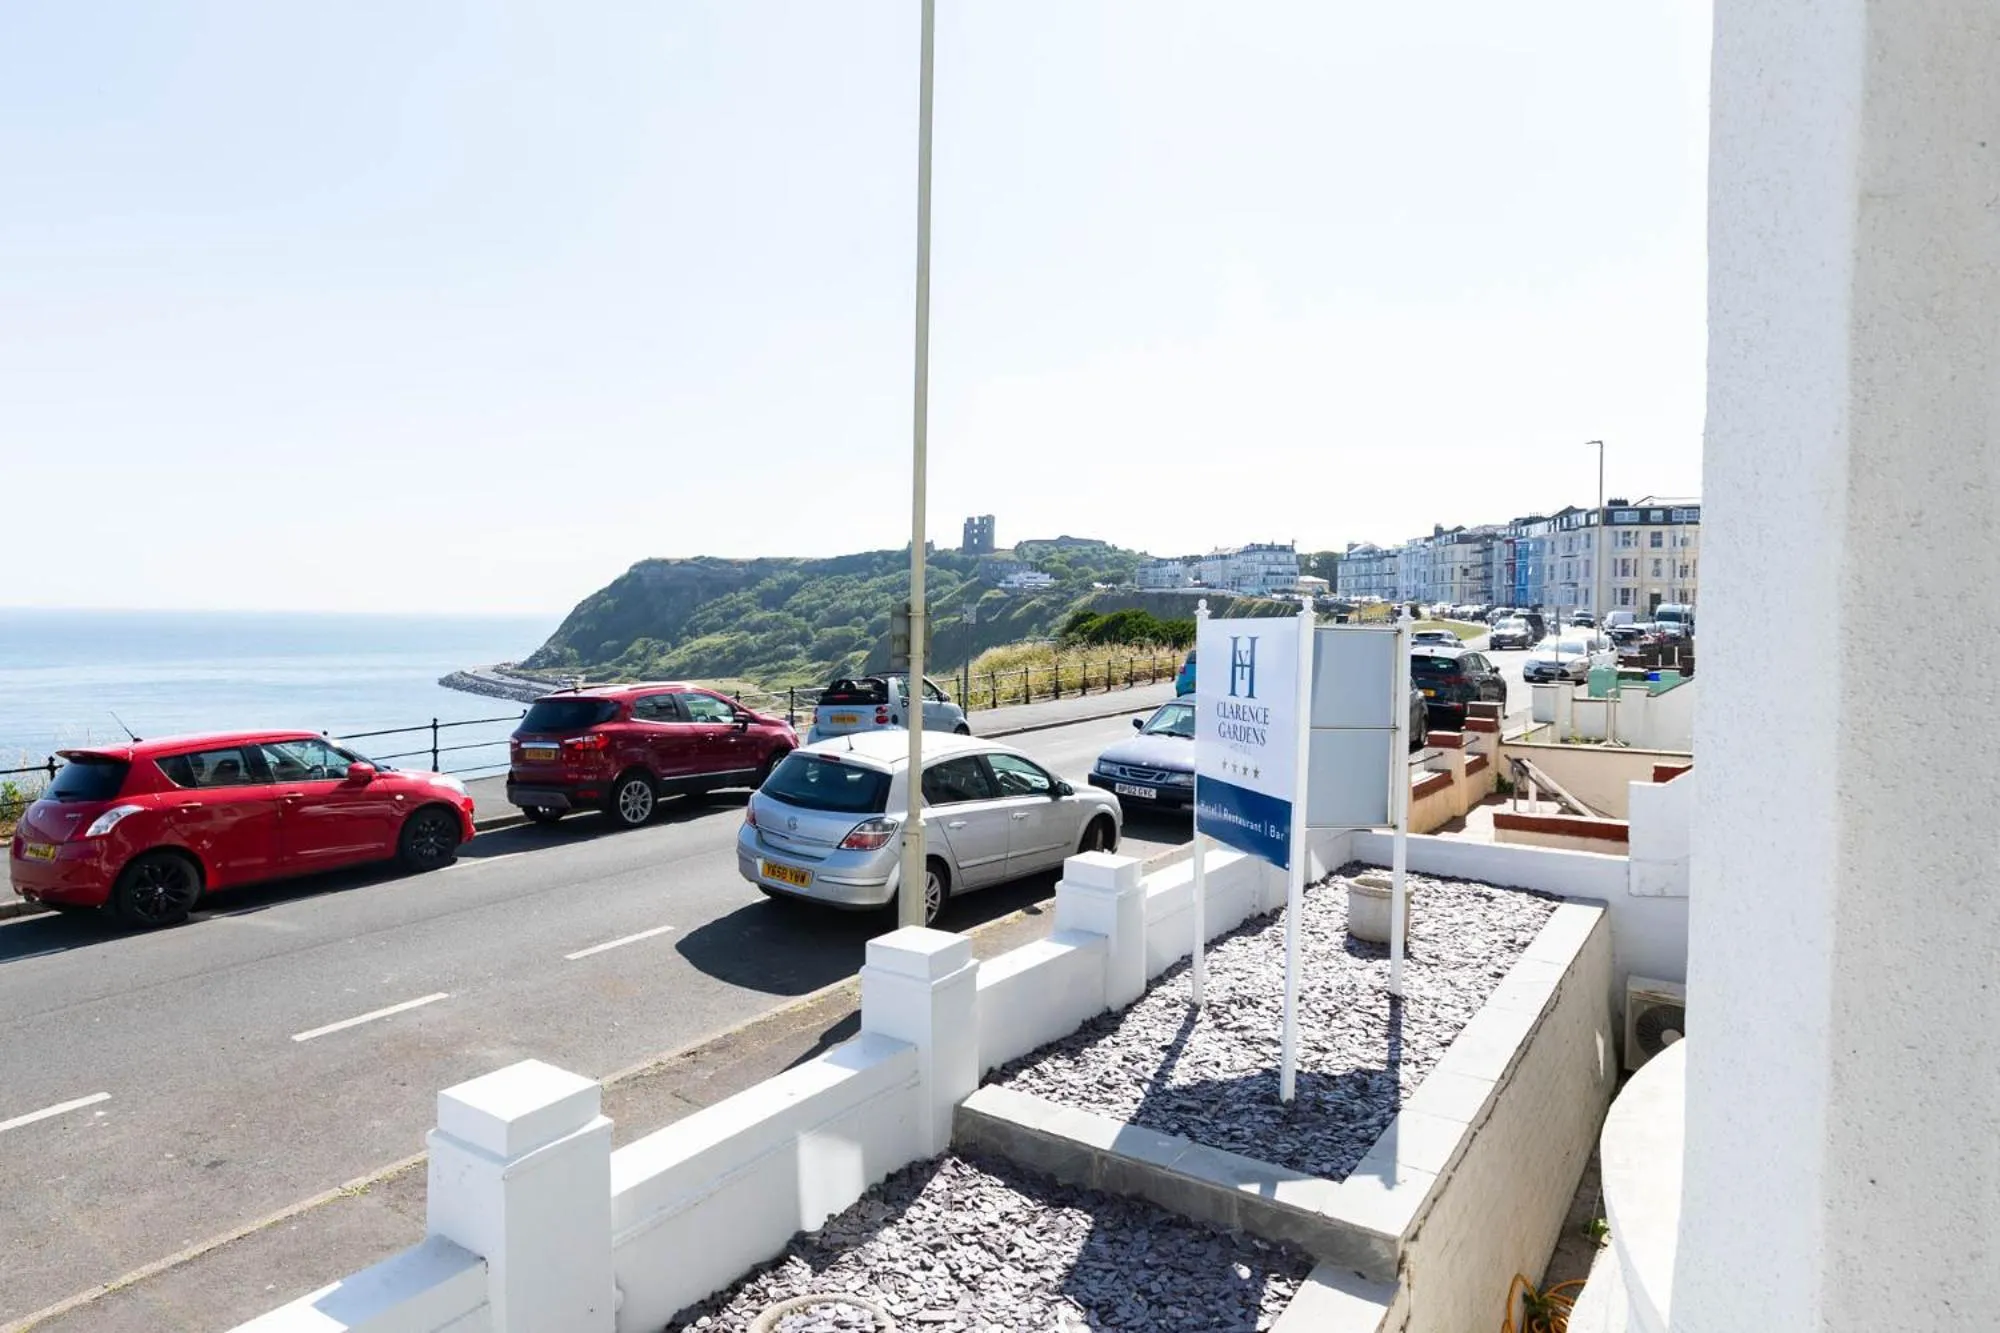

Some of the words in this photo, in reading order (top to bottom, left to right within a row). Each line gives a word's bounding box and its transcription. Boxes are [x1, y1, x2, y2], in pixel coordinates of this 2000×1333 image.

[1216, 701, 1270, 725] CLARENCE
[1218, 721, 1267, 747] GARDENS
[1223, 807, 1262, 833] Restaurant
[1270, 825, 1286, 841] Bar
